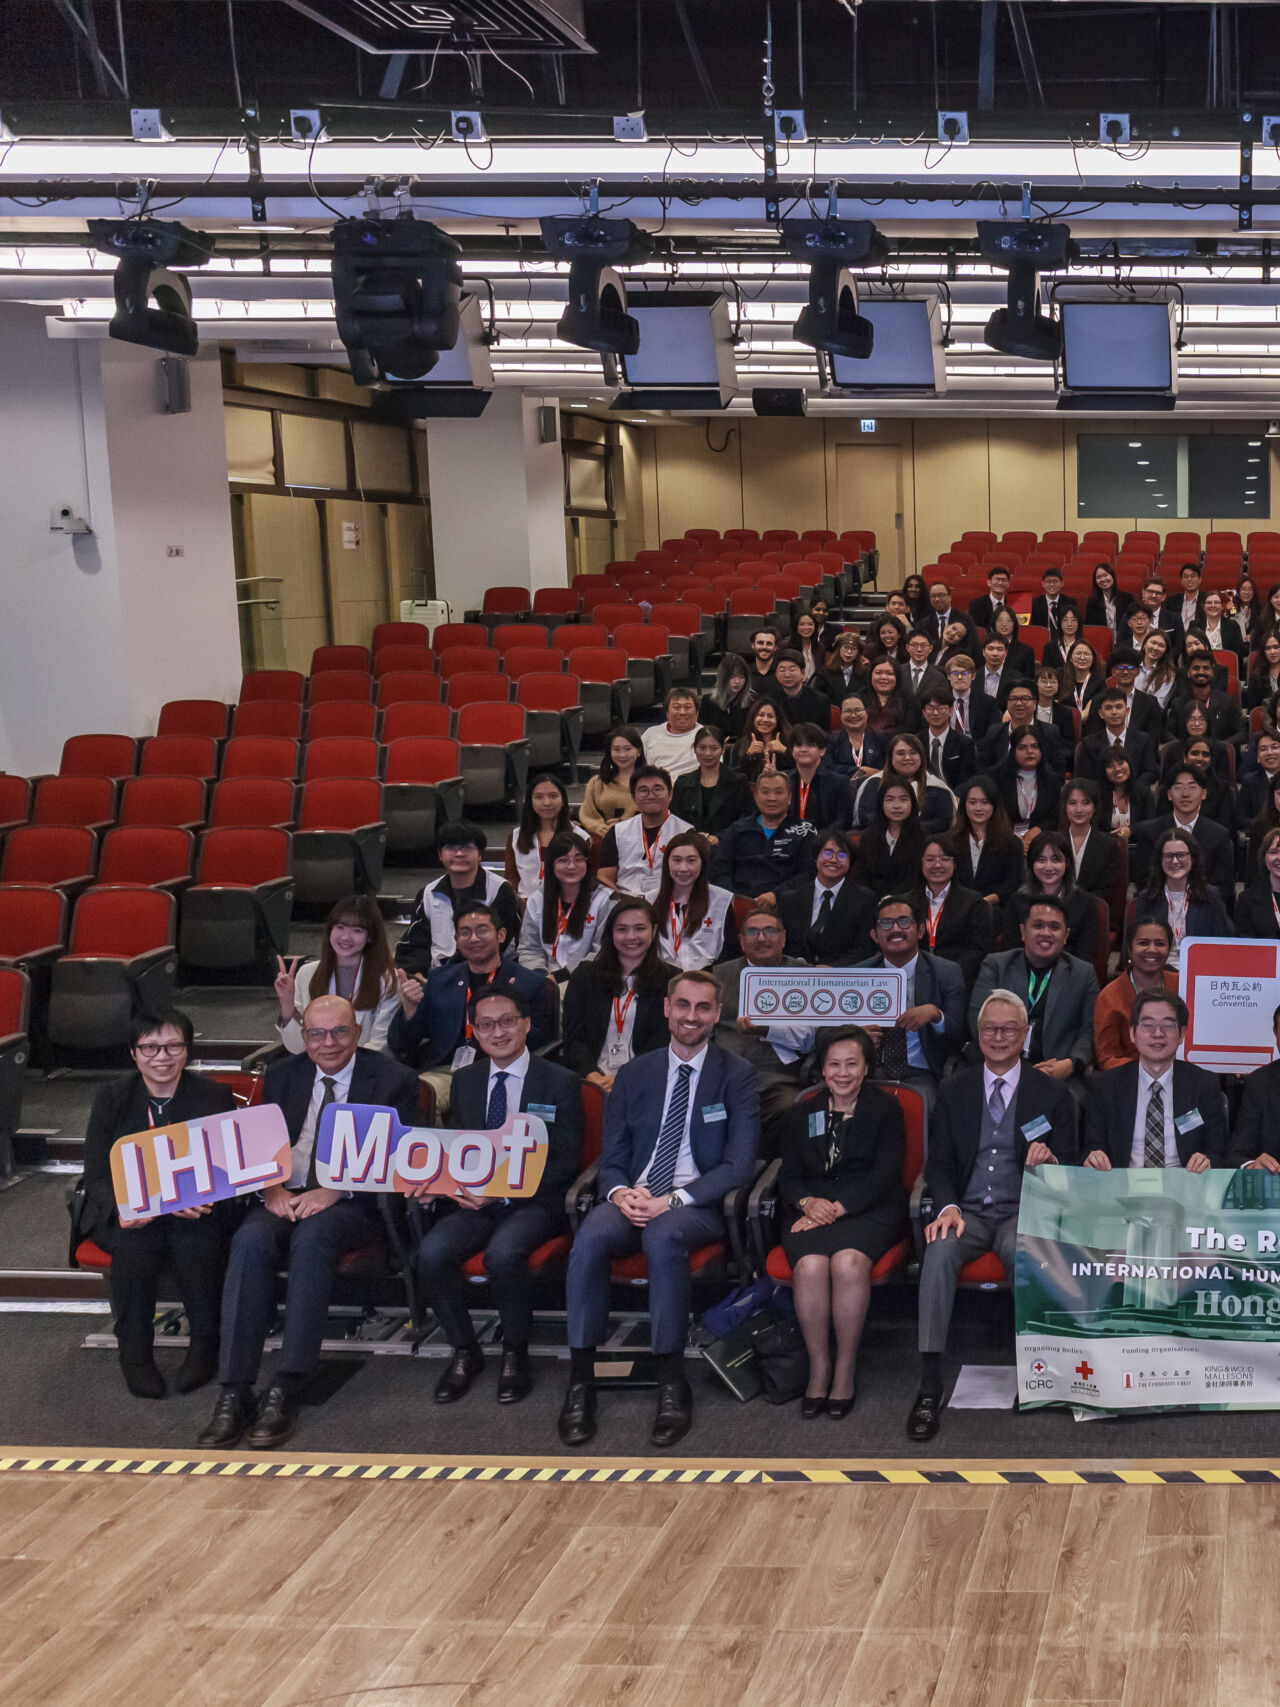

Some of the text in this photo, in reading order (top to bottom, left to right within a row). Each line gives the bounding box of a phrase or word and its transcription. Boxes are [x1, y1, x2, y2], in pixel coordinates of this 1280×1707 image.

[758, 977, 888, 987] International Humanitarian Law
[1210, 980, 1262, 992] 日內瓦公約
[1219, 992, 1251, 1001] Geneva
[1211, 999, 1258, 1008] Convention
[327, 1110, 537, 1191] Moot
[120, 1118, 284, 1212] IHL
[1185, 1227, 1247, 1251] The
[1072, 1262, 1235, 1281] INTERNATIONAL
[1122, 1347, 1149, 1355] Funding
[1204, 1372, 1254, 1380] MALLESONS
[1025, 1379, 1054, 1390] ICRC
